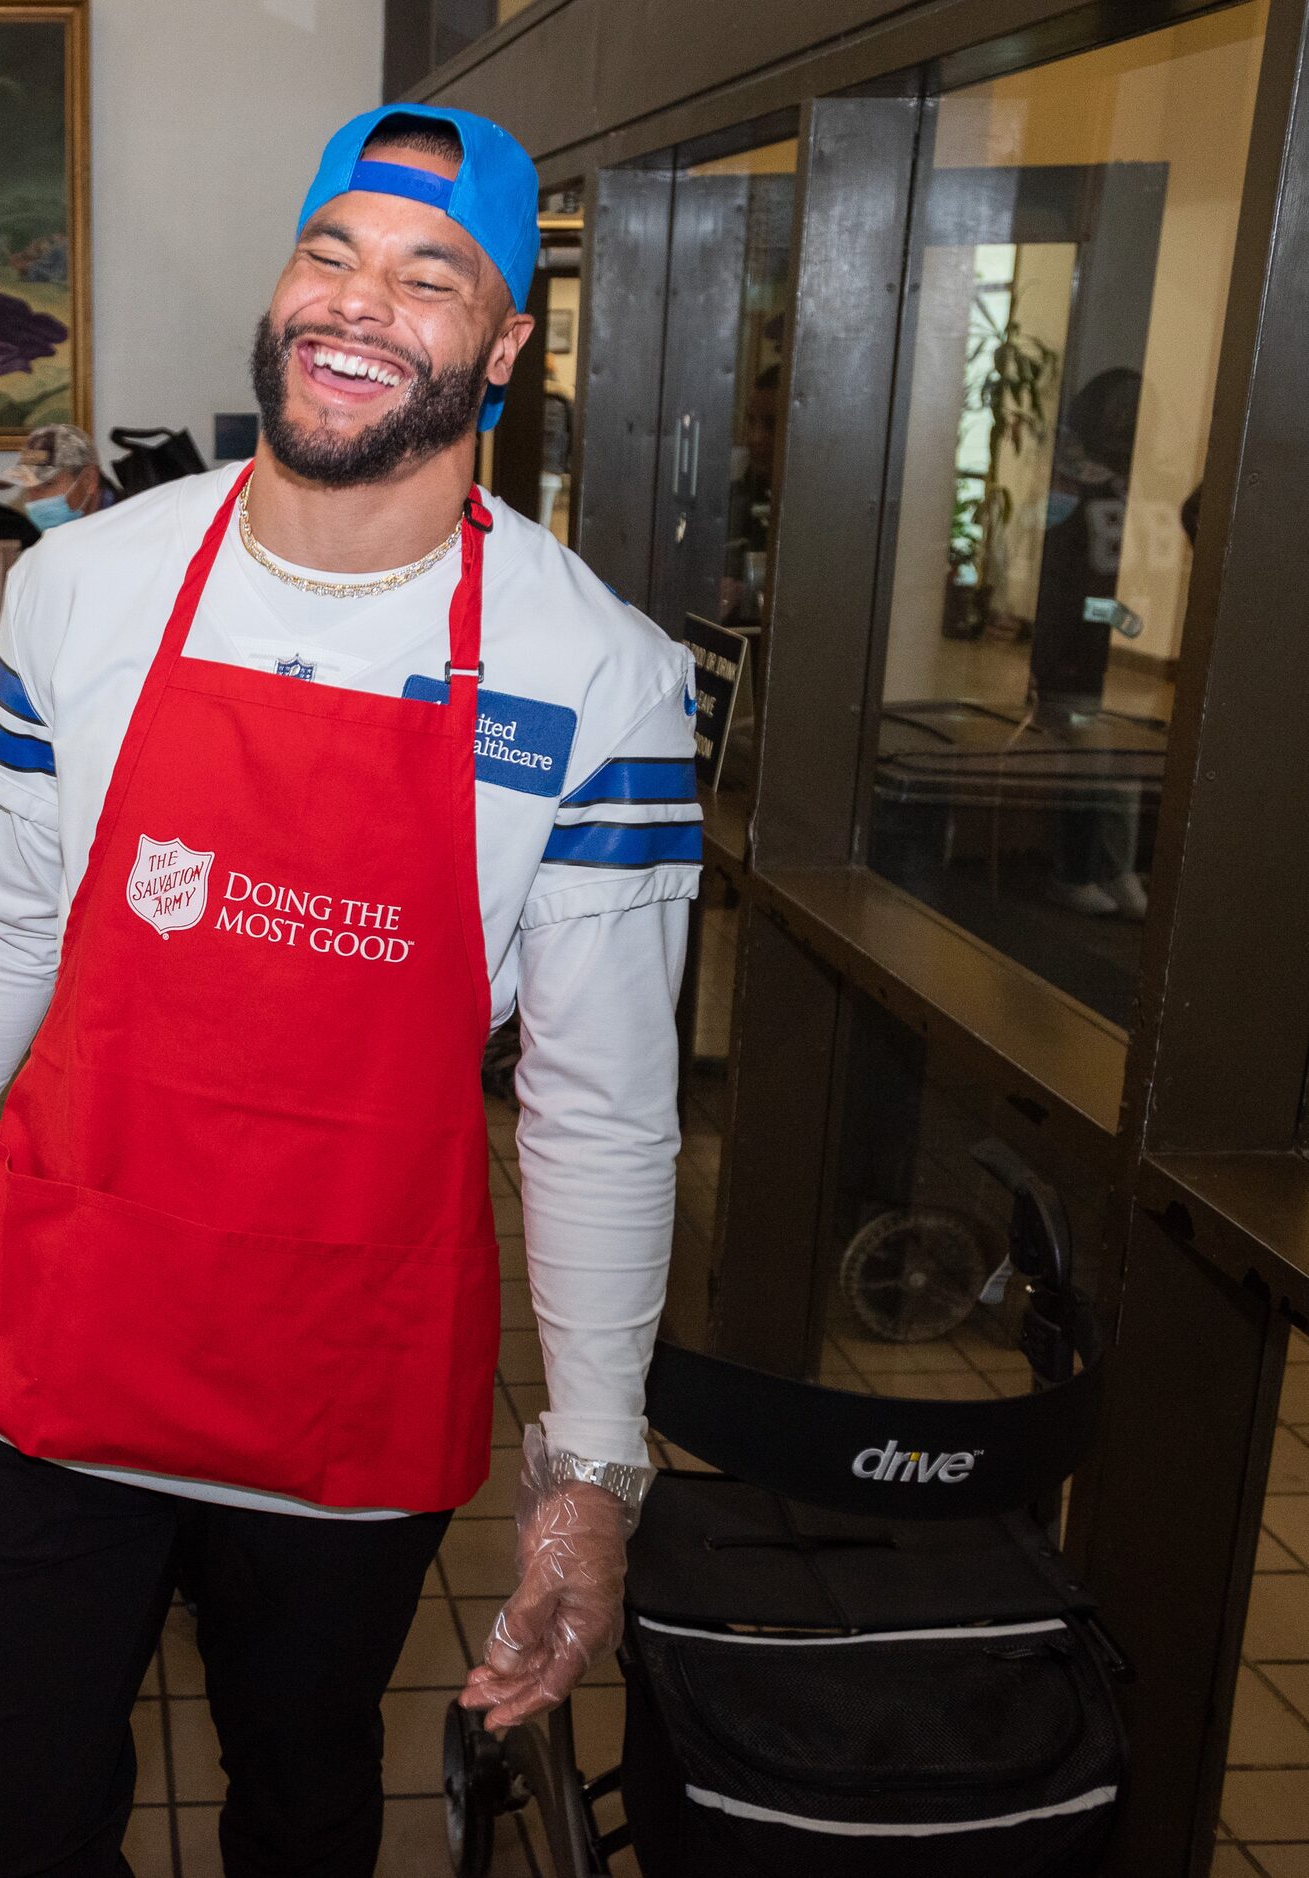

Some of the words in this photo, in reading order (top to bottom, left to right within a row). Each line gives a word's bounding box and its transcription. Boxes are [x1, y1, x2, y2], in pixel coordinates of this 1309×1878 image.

[475, 713, 517, 741] ited
[473, 736, 553, 771] althcare
[149, 850, 178, 872] THE
[132, 861, 204, 901] SALVATION
[152, 887, 196, 918] ARMY
[223, 871, 332, 921] DOING
[341, 899, 402, 931] THE
[214, 906, 304, 946] MOST
[309, 927, 410, 963] GOOD
[852, 1440, 976, 1483] drive
